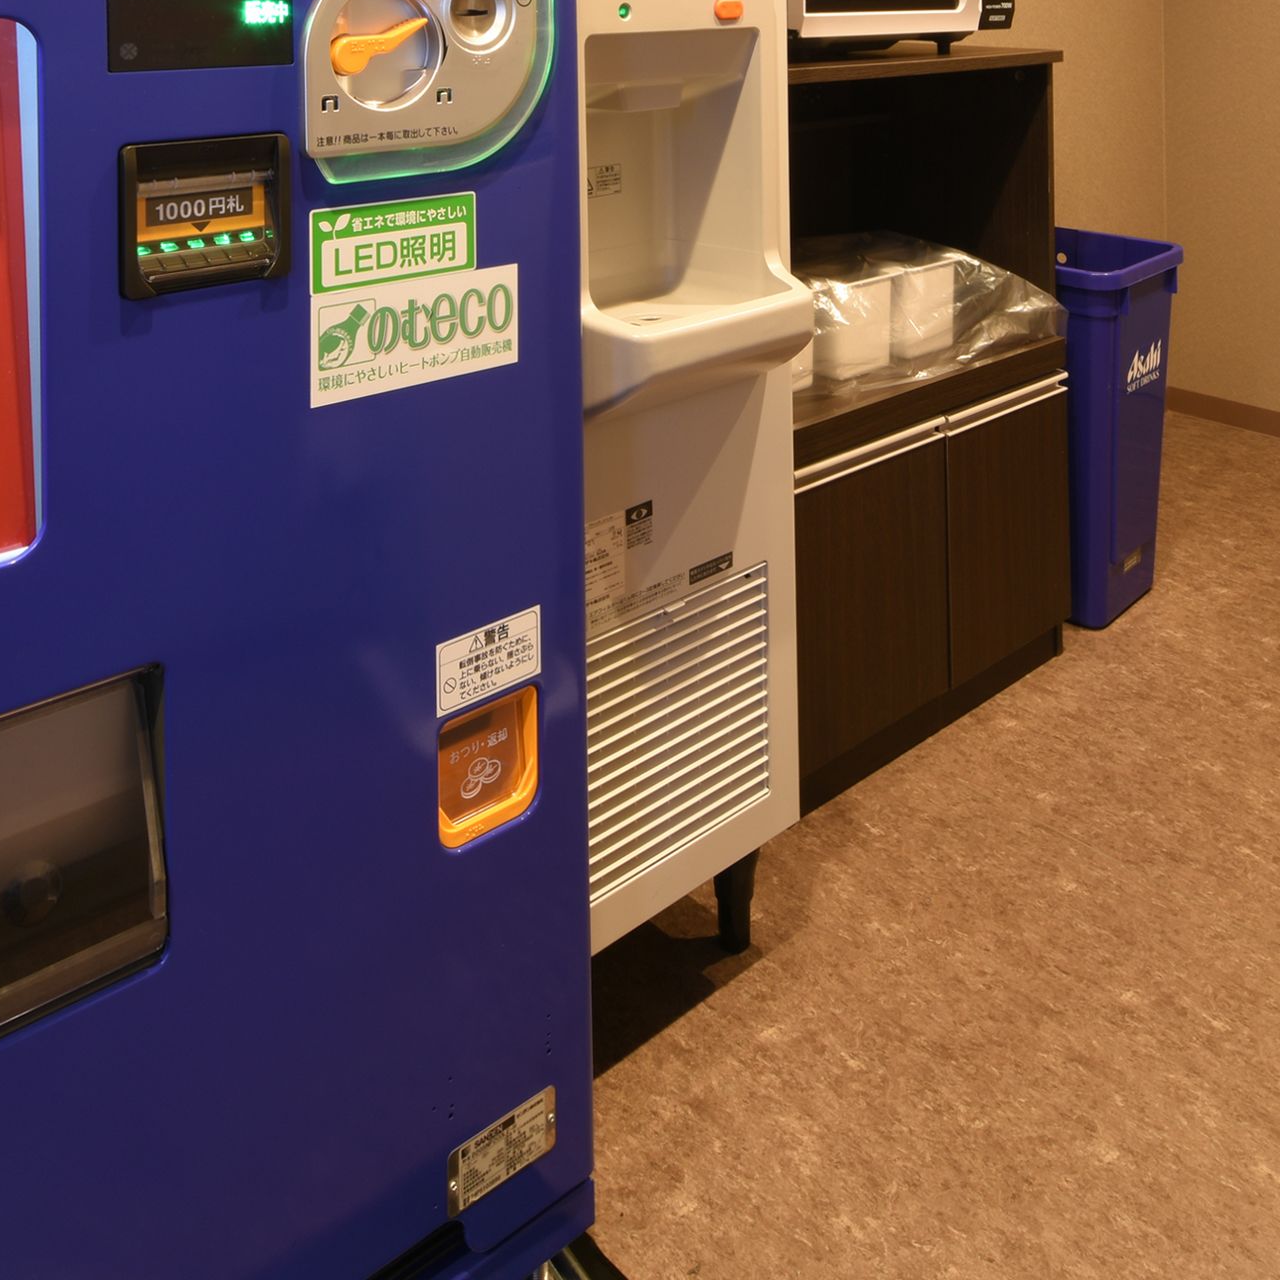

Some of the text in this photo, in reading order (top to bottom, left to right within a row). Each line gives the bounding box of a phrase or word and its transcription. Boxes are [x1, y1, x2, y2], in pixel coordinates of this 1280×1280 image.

[155, 194, 245, 222] 1000円札
[351, 205, 468, 233] 省エネで環境にやさしい
[334, 229, 457, 277] LED照明
[318, 338, 513, 392] 環境にやさしいヒートポンプ自動販売機
[1127, 338, 1163, 383] Asahi
[1126, 369, 1161, 395] SOFT DRINKS
[484, 623, 510, 647] 警告
[449, 727, 508, 765] おつり・返却
